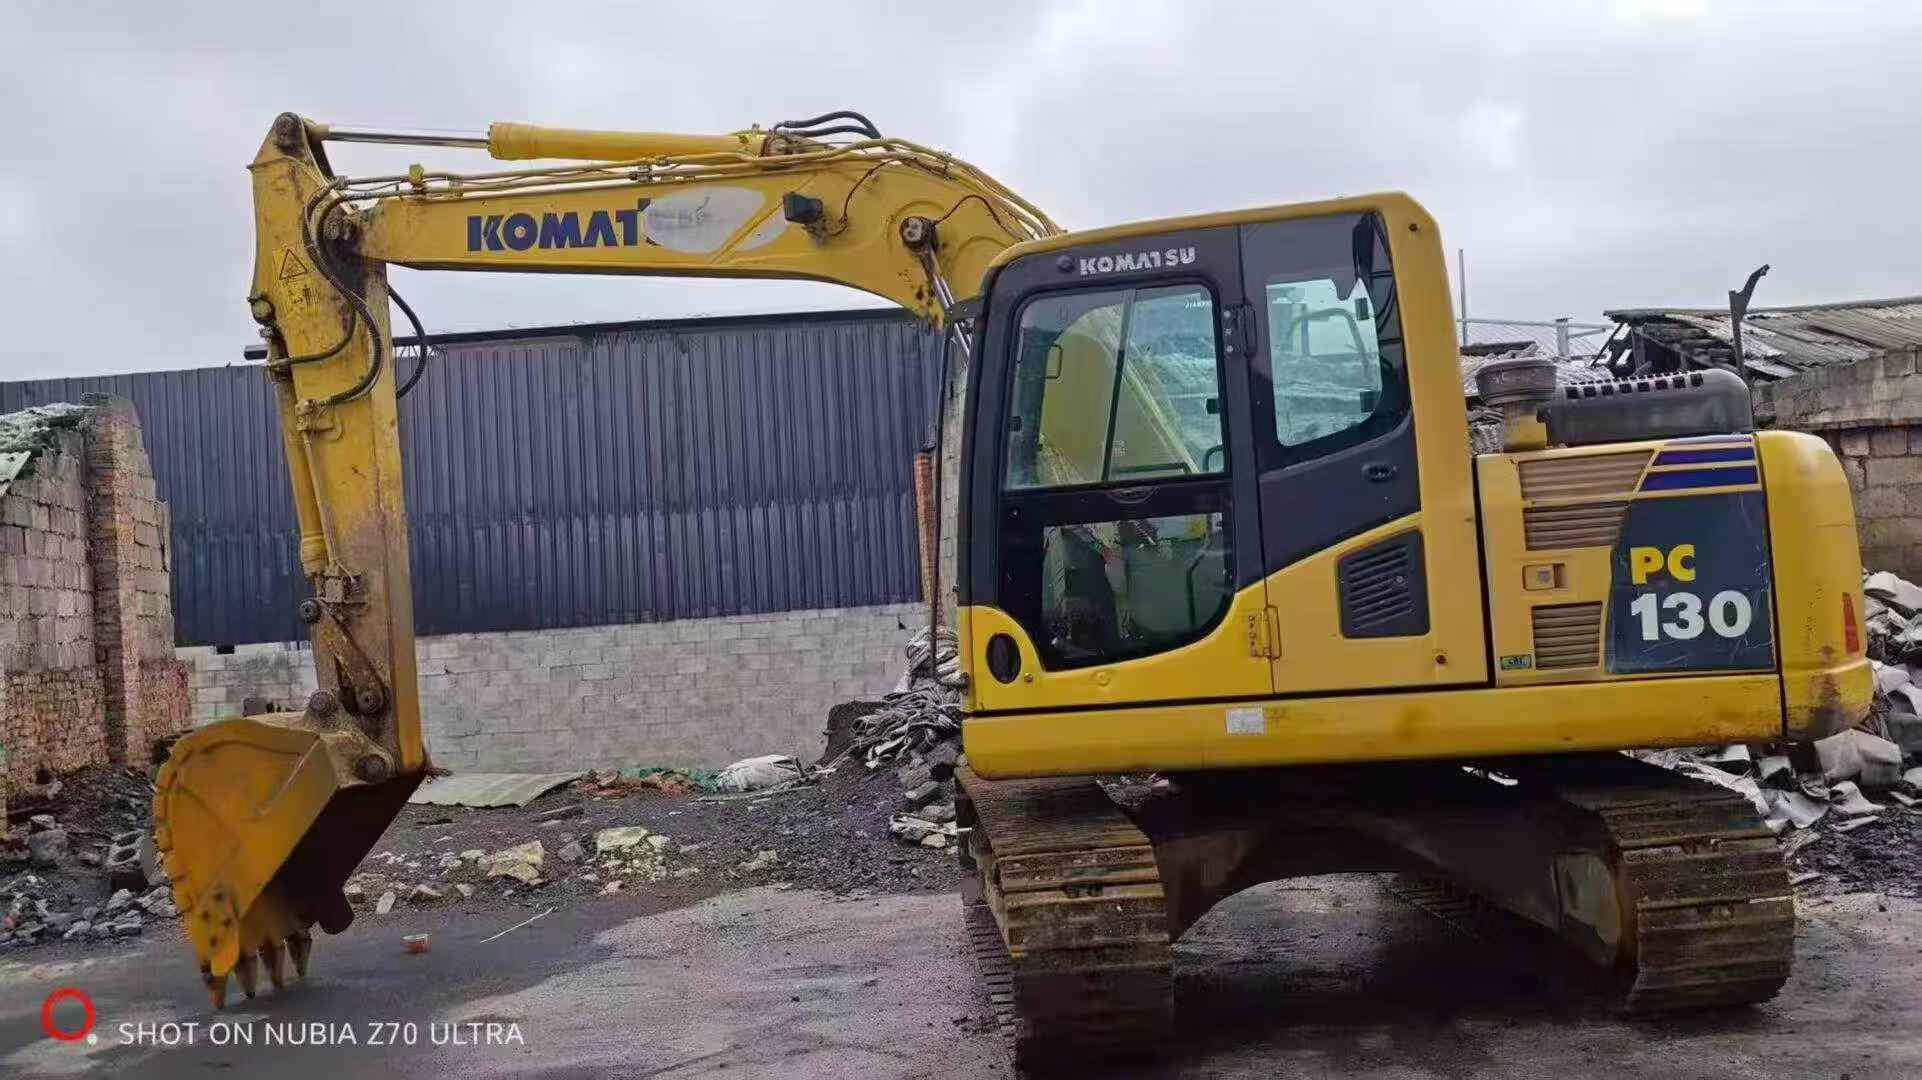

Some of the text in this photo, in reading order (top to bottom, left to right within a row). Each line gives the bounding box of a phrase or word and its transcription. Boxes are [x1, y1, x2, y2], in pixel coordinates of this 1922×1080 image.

[466, 198, 655, 251] KOMAT
[1079, 246, 1196, 275] KOMATSU
[1630, 543, 1696, 585] PC
[1631, 590, 1752, 641] 130
